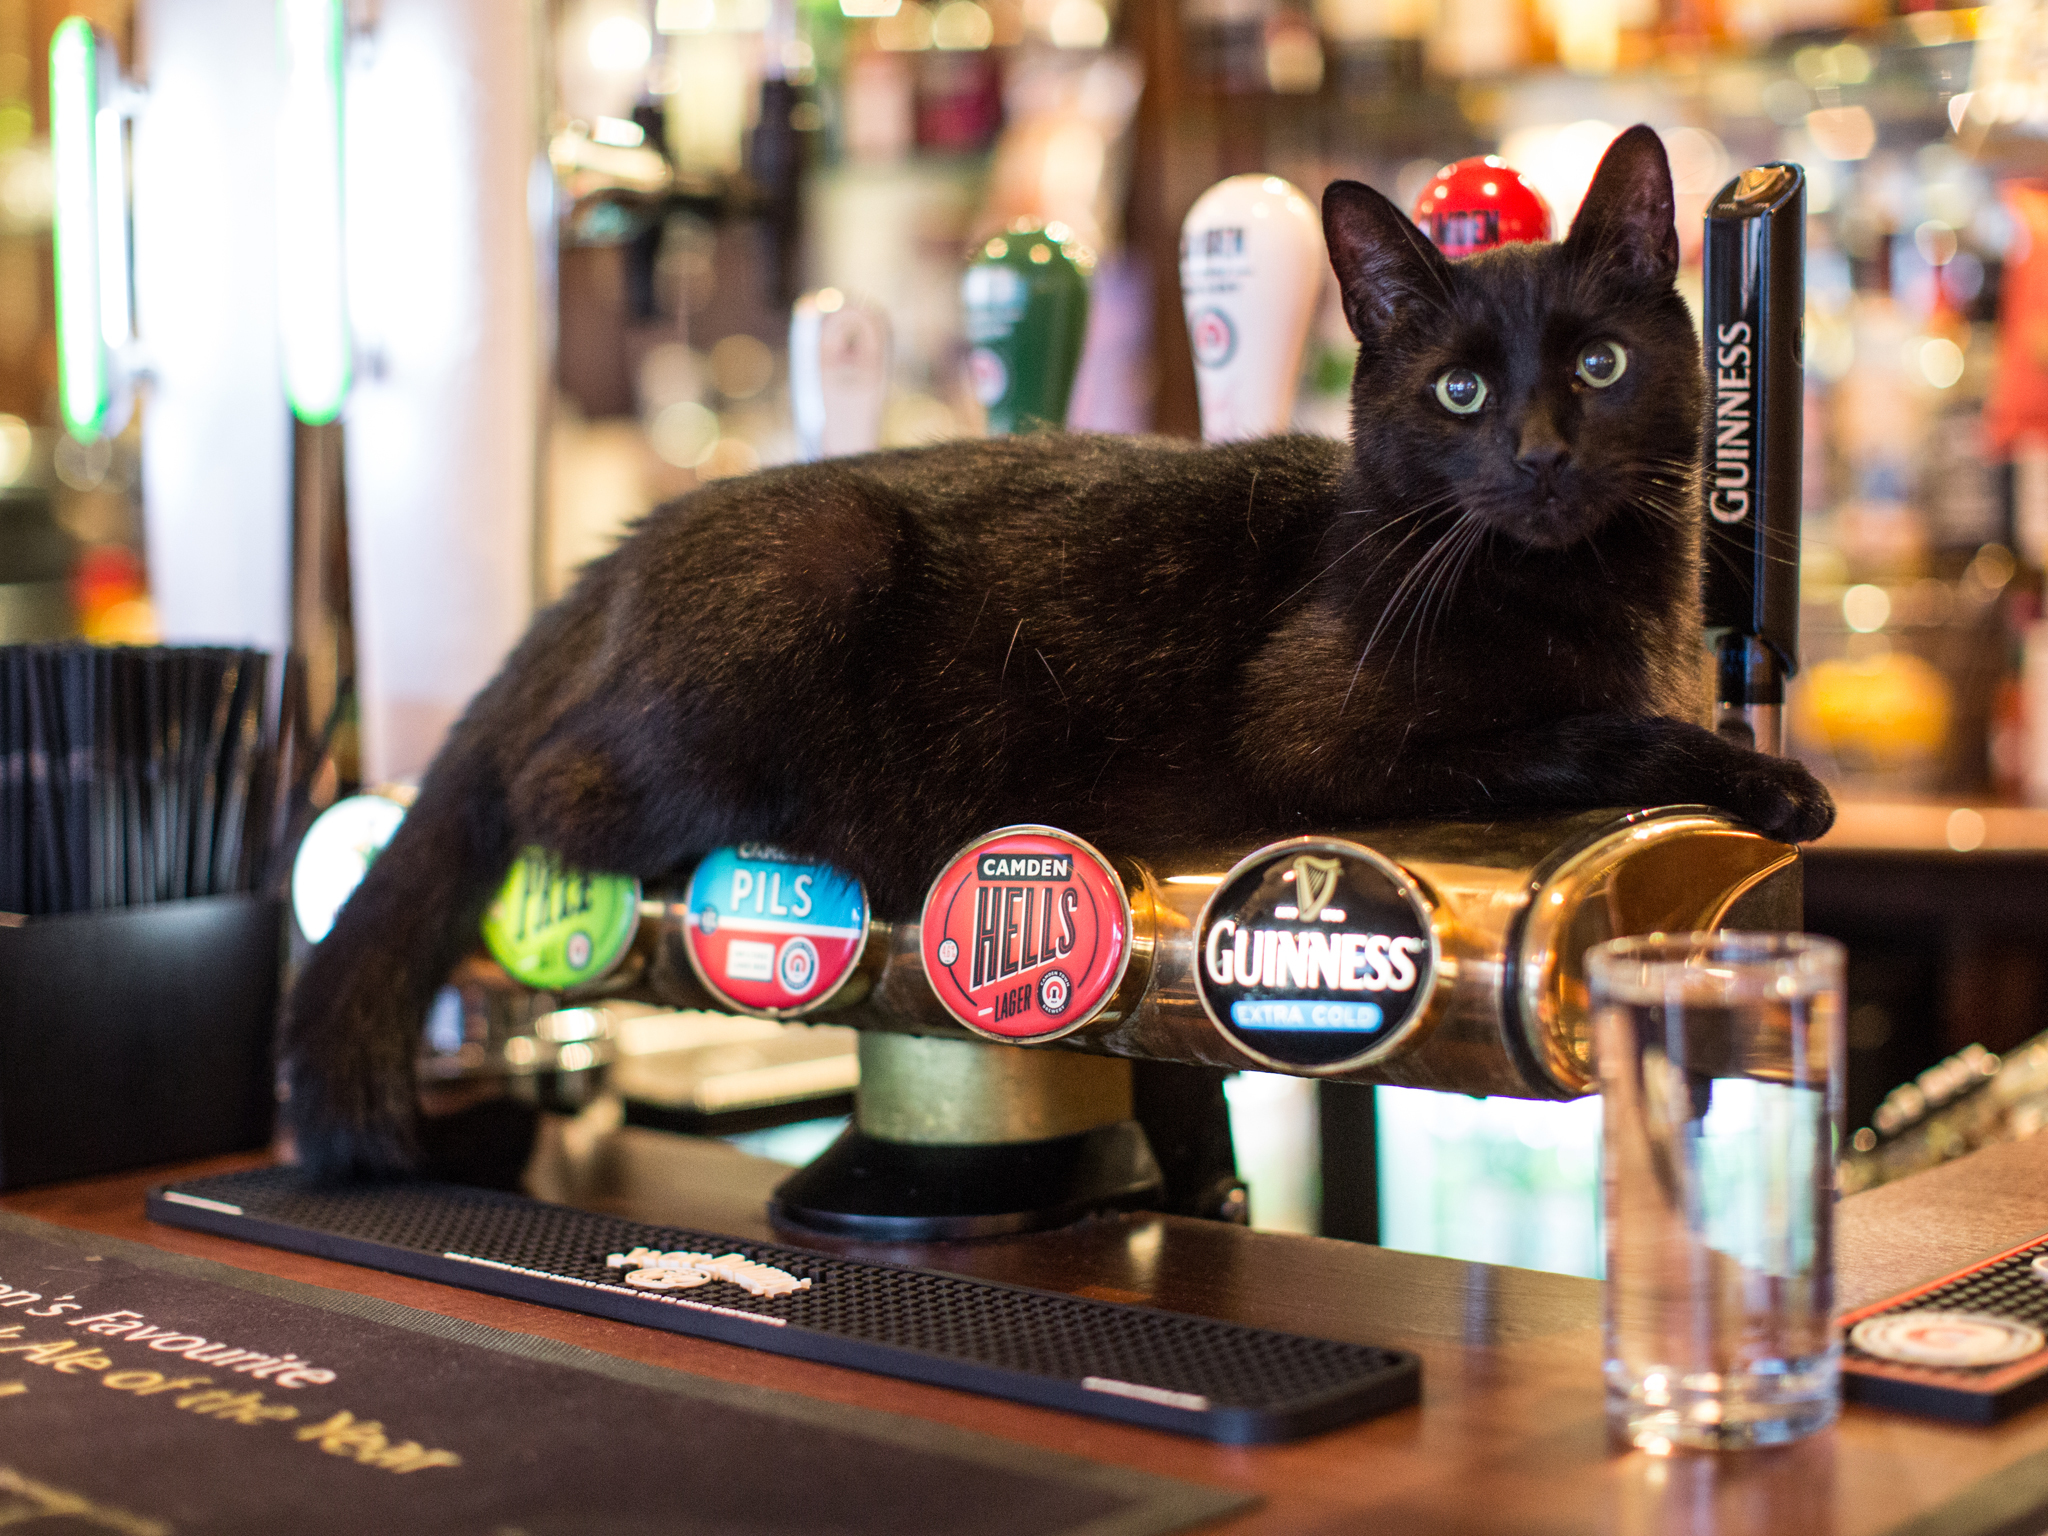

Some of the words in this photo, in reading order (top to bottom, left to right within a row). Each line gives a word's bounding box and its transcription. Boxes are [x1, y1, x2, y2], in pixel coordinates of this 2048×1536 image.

[1709, 320, 1752, 523] GUINNESS
[731, 868, 812, 917] PILS
[983, 859, 1068, 877] CAMDEN
[969, 886, 1079, 992] HELLS
[1206, 919, 1417, 992] GUINNESS
[994, 984, 1032, 1023] LAGER
[1236, 1004, 1305, 1025] EXTRA
[1311, 1004, 1375, 1028] COLD
[0, 1339, 112, 1374] Ale
[102, 1370, 214, 1397] of
[66, 1310, 337, 1389] Favourite
